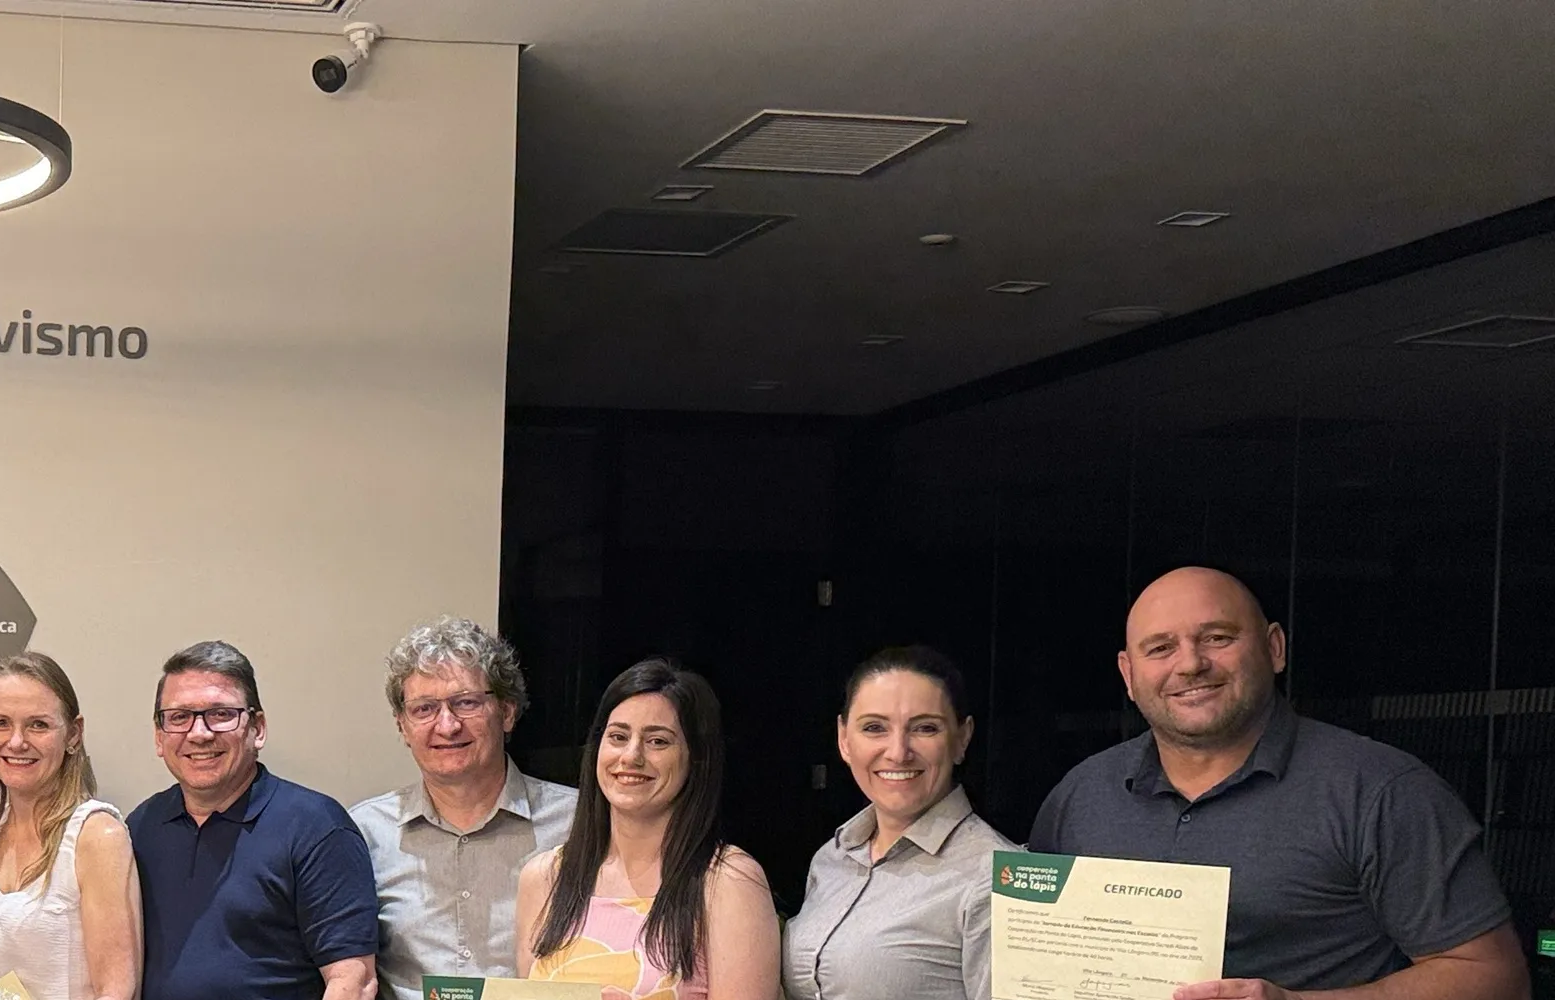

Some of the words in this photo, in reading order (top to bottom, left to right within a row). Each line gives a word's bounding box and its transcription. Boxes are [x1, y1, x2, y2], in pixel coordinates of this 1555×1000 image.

[1029, 873, 1056, 883] ponta
[1014, 880, 1027, 889] do
[1029, 880, 1056, 893] lápis
[1104, 883, 1182, 899] CERTIFICADO
